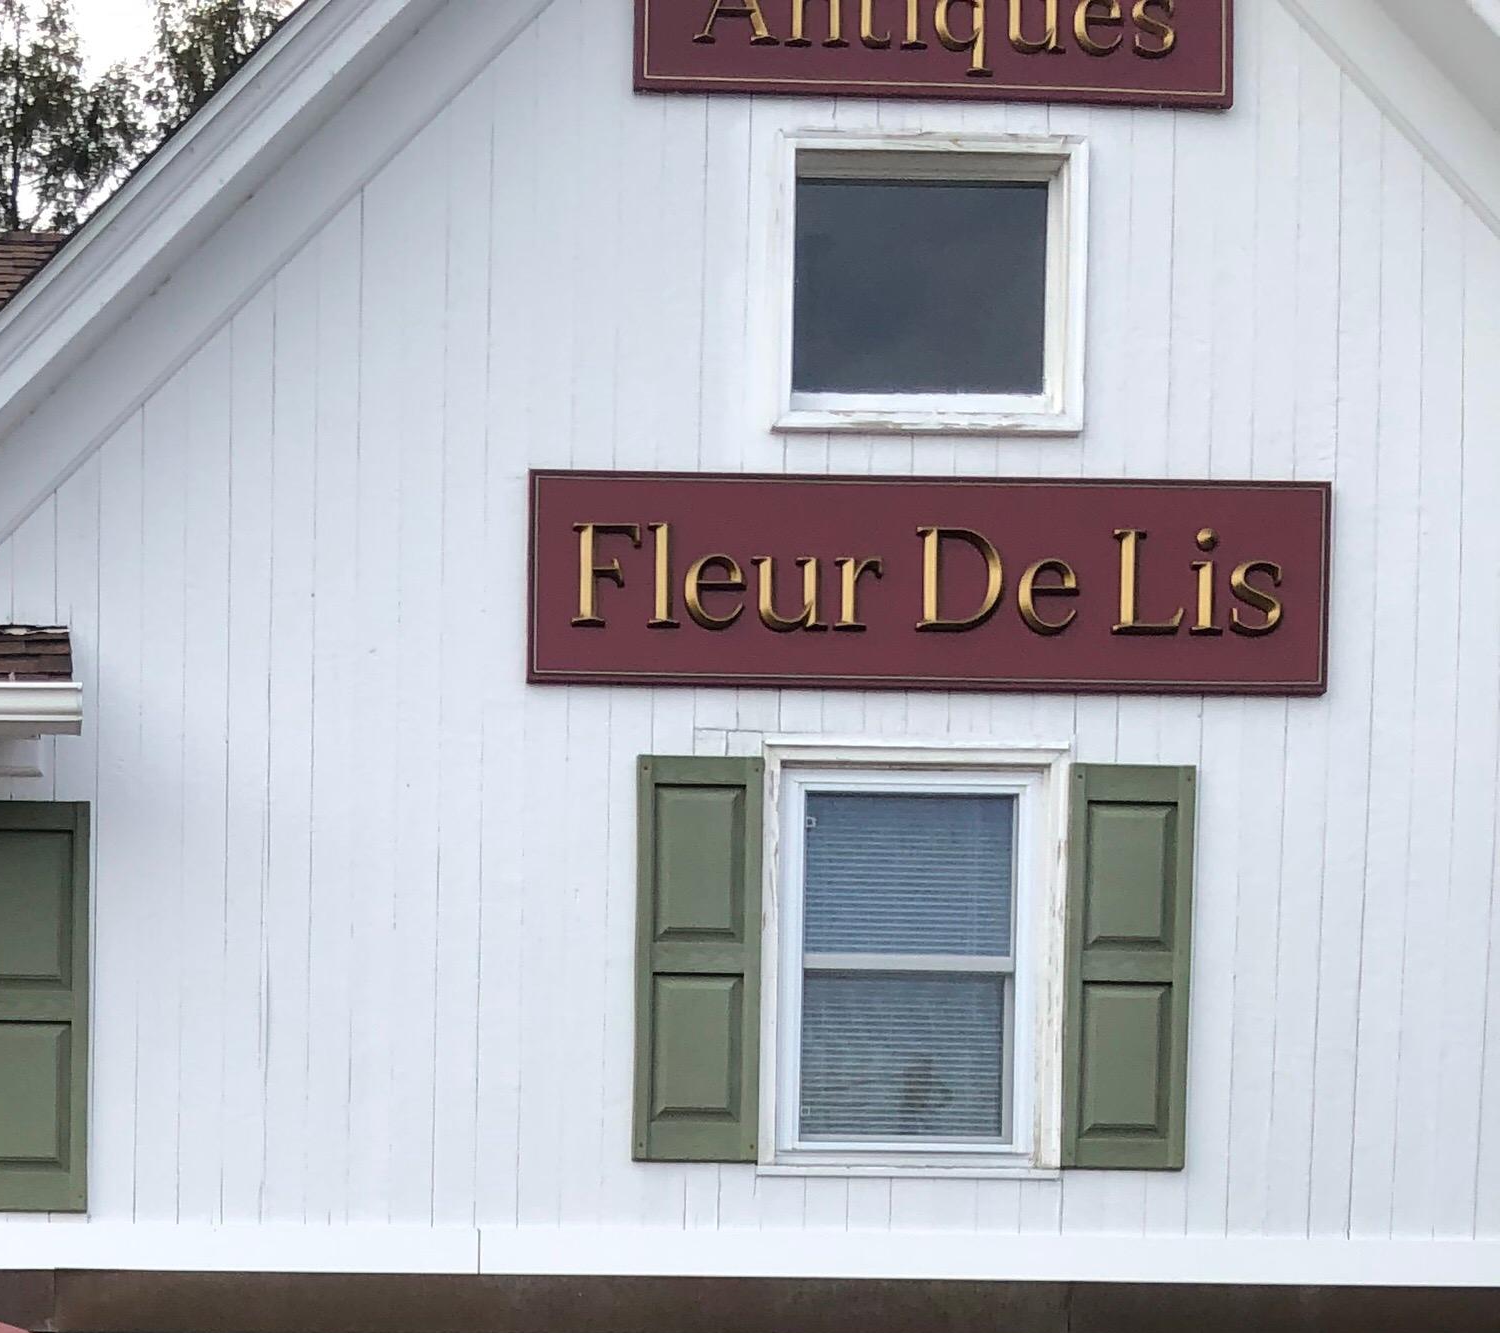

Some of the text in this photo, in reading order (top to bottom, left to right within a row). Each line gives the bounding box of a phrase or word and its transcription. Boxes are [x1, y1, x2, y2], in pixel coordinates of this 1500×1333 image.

[692, 0, 1177, 78] Antiques
[571, 522, 1283, 637] Fleur De Lis
